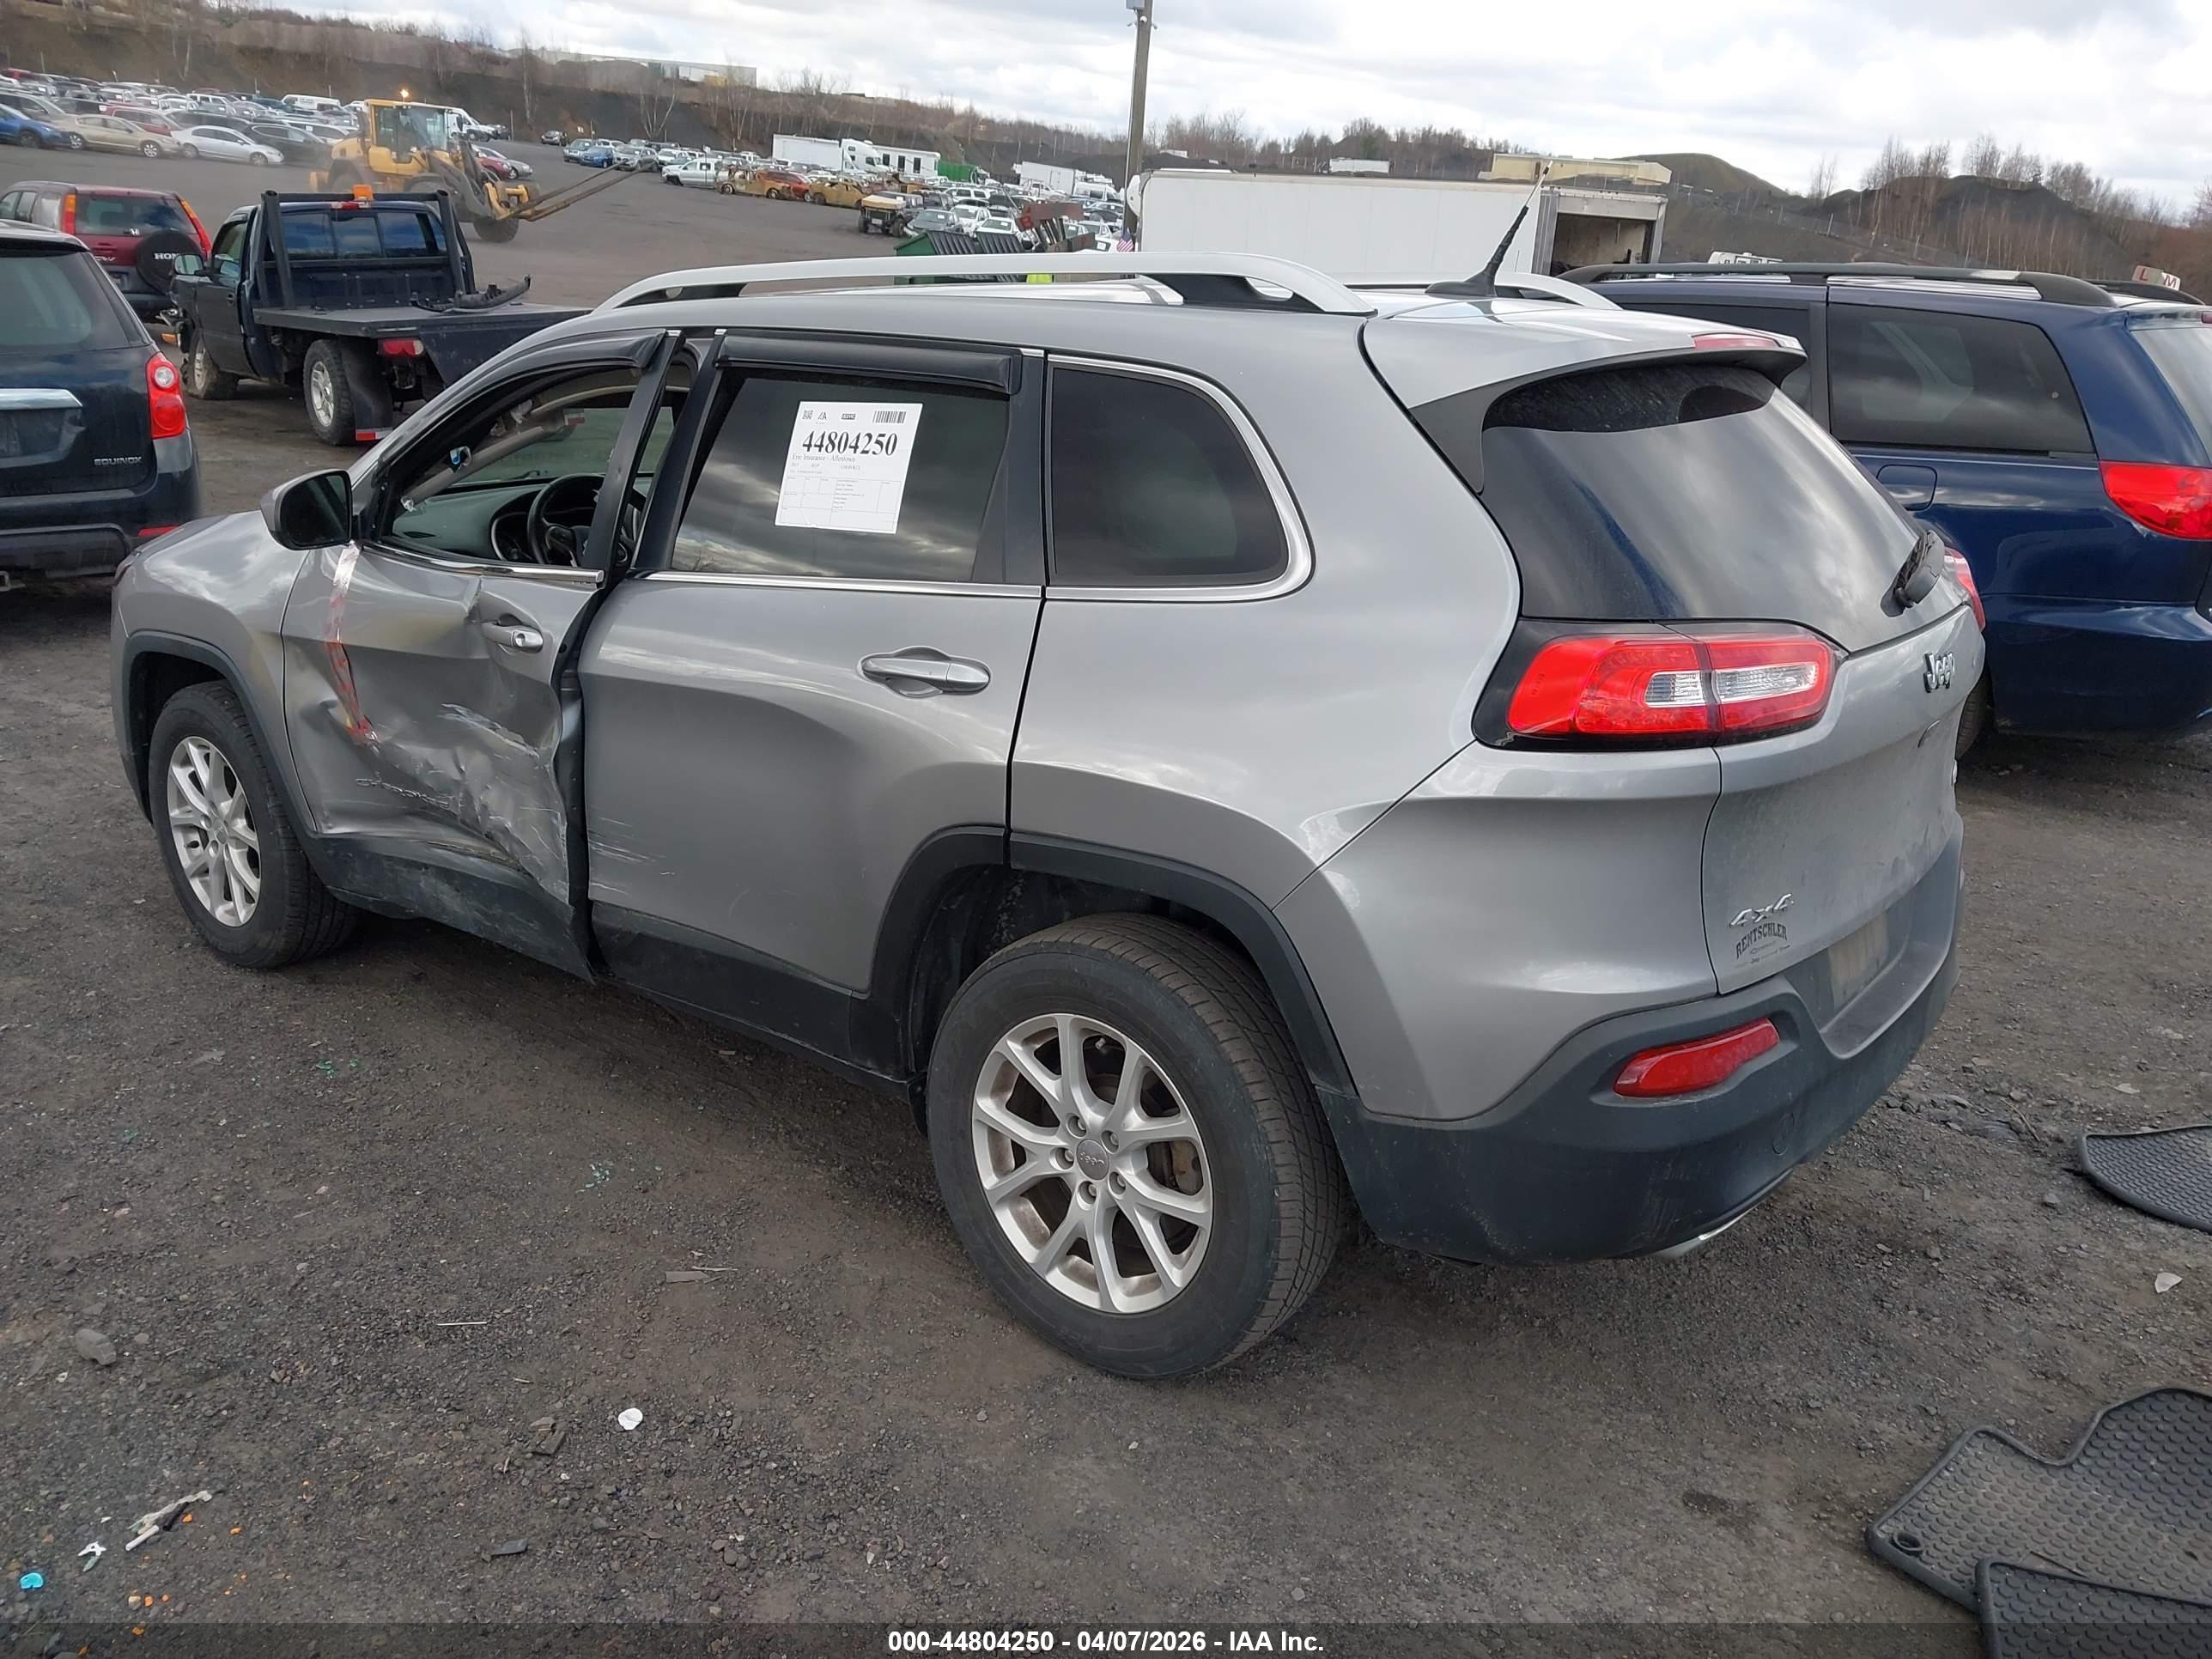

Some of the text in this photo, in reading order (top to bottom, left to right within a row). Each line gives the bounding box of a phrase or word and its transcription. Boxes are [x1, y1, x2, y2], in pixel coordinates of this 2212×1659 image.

[802, 430, 898, 456] 44804250
[94, 456, 142, 465] EQUINOX
[1923, 652, 1954, 693] Jeep
[1736, 922, 1788, 959] RENTSCHLER
